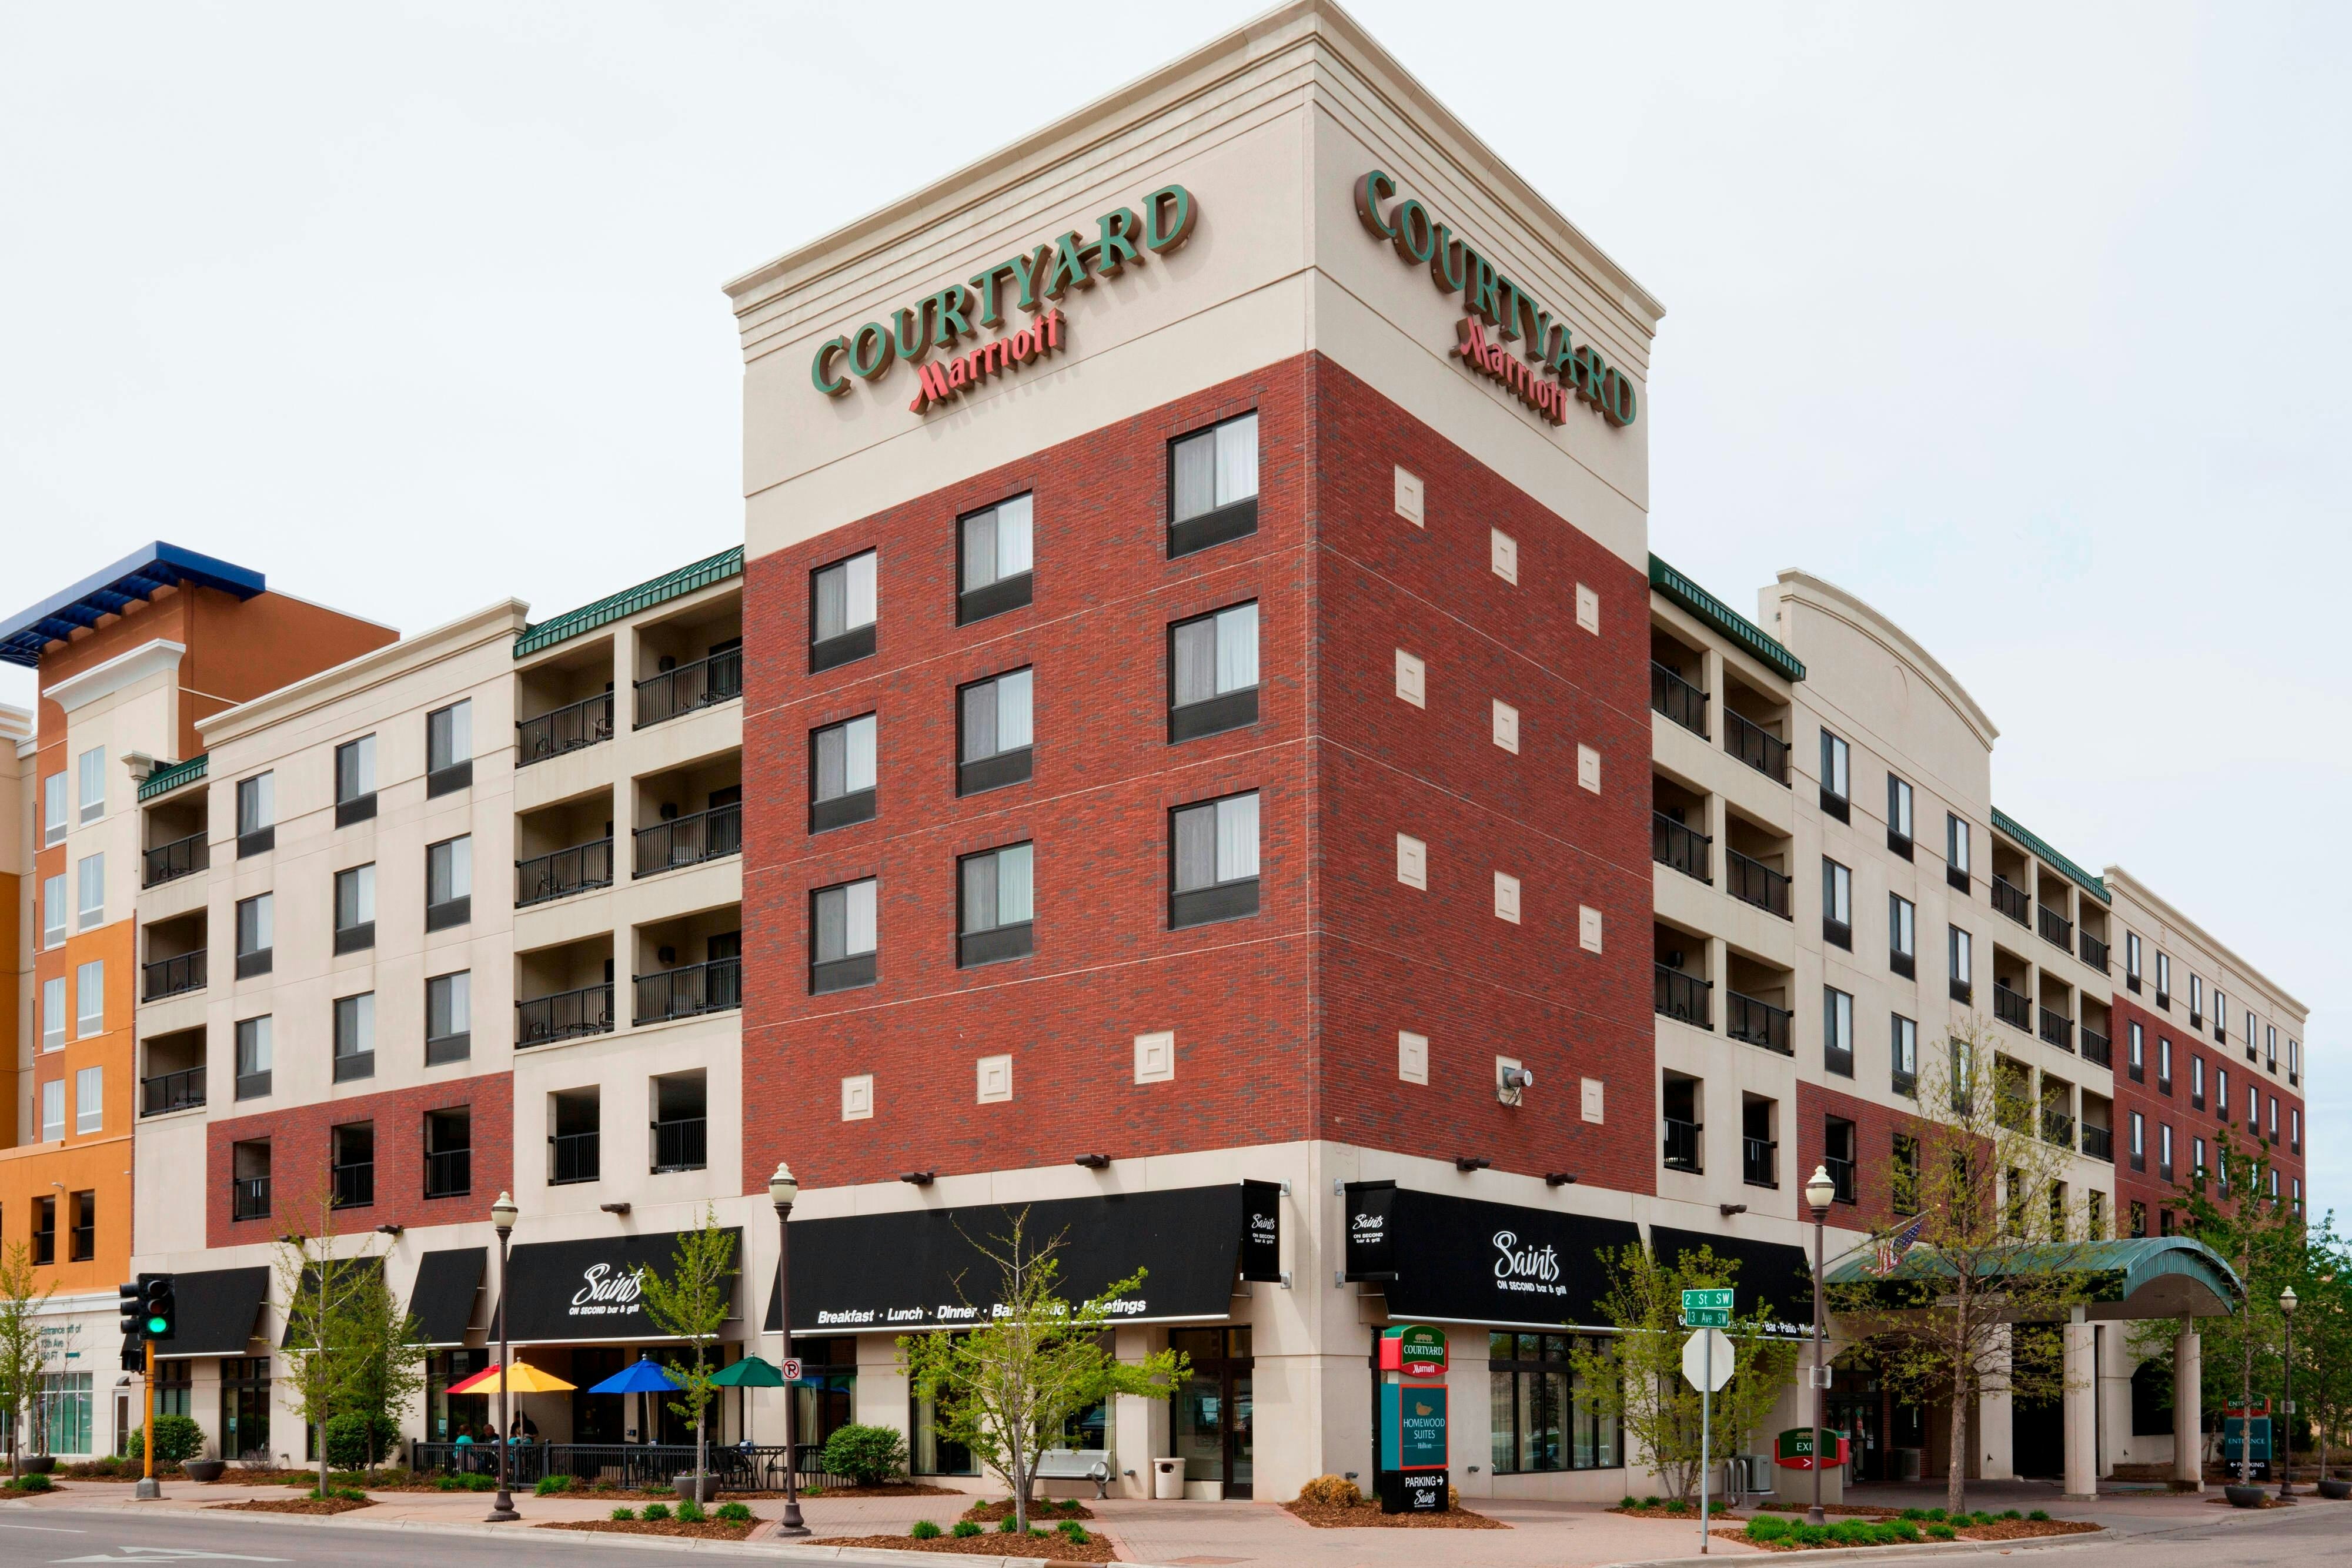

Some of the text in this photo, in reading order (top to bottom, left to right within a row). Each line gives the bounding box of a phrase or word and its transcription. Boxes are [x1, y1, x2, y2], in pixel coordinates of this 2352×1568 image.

[811, 184, 1198, 397] COURTYARD
[1354, 169, 1637, 427] COURTYARD
[908, 307, 1067, 416] Marriott
[1450, 315, 1567, 427] Marriott
[1251, 1213, 1275, 1230] Saints
[1352, 1213, 1384, 1229] Saints
[1493, 1231, 1559, 1282] Saints
[572, 1263, 646, 1305] Saints
[1497, 1280, 1567, 1296] ON SECOND bar & grill
[1685, 1293, 1729, 1305] 2 St SW
[569, 1304, 640, 1315] ON SECOND bar & grill
[818, 1309, 874, 1323] Breakfast
[887, 1306, 923, 1320] Lunch
[937, 1305, 977, 1319] Dinner
[1688, 1311, 1695, 1323] 13
[1701, 1312, 1712, 1323] Ave
[1718, 1312, 1726, 1324] SW
[41, 1326, 65, 1335] Entrance
[75, 1323, 81, 1333] of
[1763, 1321, 1776, 1332] Bar
[1780, 1322, 1796, 1333] Patio
[1799, 1323, 1826, 1336] Meets
[54, 1339, 64, 1347] Ave
[51, 1351, 58, 1360] FT
[1404, 1345, 1443, 1356] COURTYARD
[1413, 1364, 1435, 1373] Marriott
[1403, 1418, 1445, 1427] HOMEWOOD
[1414, 1429, 1435, 1439] SUITES
[1796, 1442, 1813, 1451] EXI
[1405, 1476, 1436, 1487] PARKING
[1414, 1489, 1435, 1505] Saints
